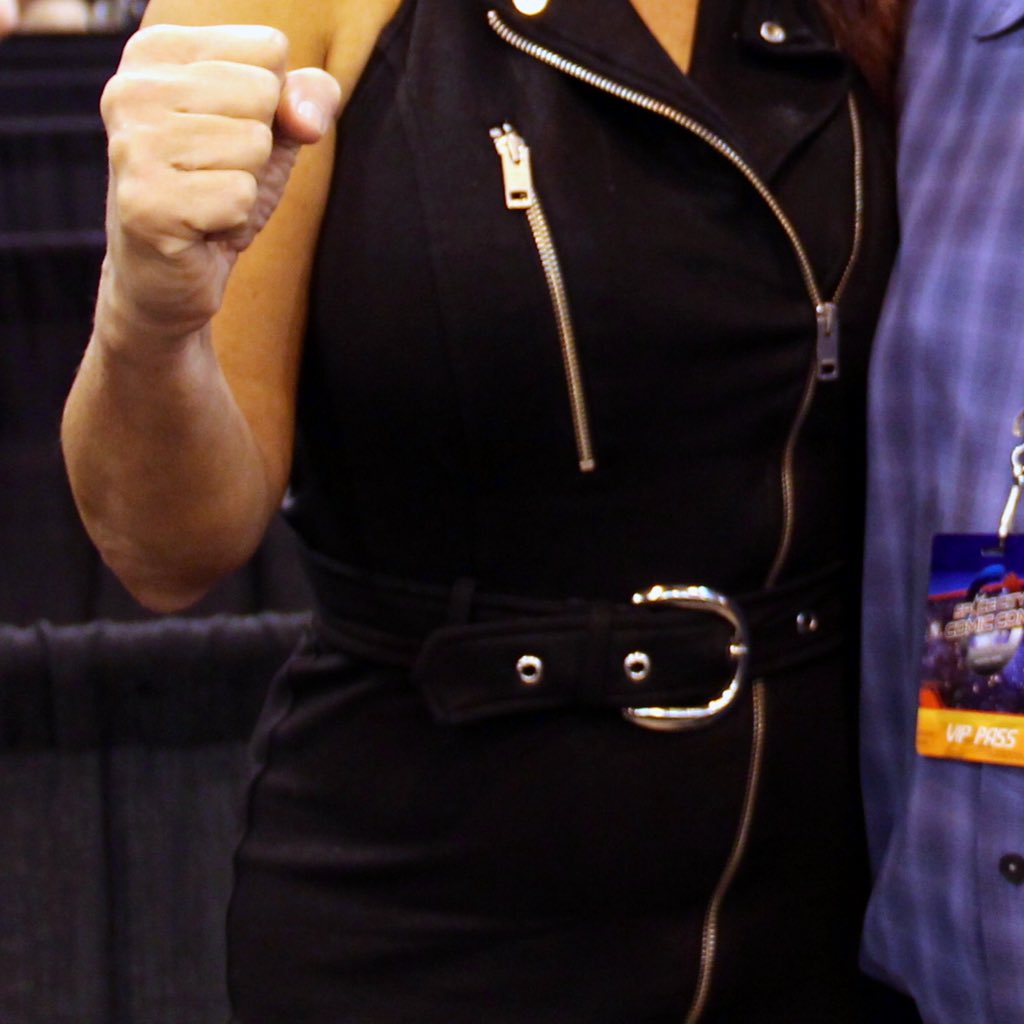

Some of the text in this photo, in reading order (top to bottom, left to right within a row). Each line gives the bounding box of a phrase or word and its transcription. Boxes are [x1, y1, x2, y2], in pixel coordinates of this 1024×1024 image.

[944, 614, 994, 638] COMIC
[946, 724, 1019, 749] VIP PASS
